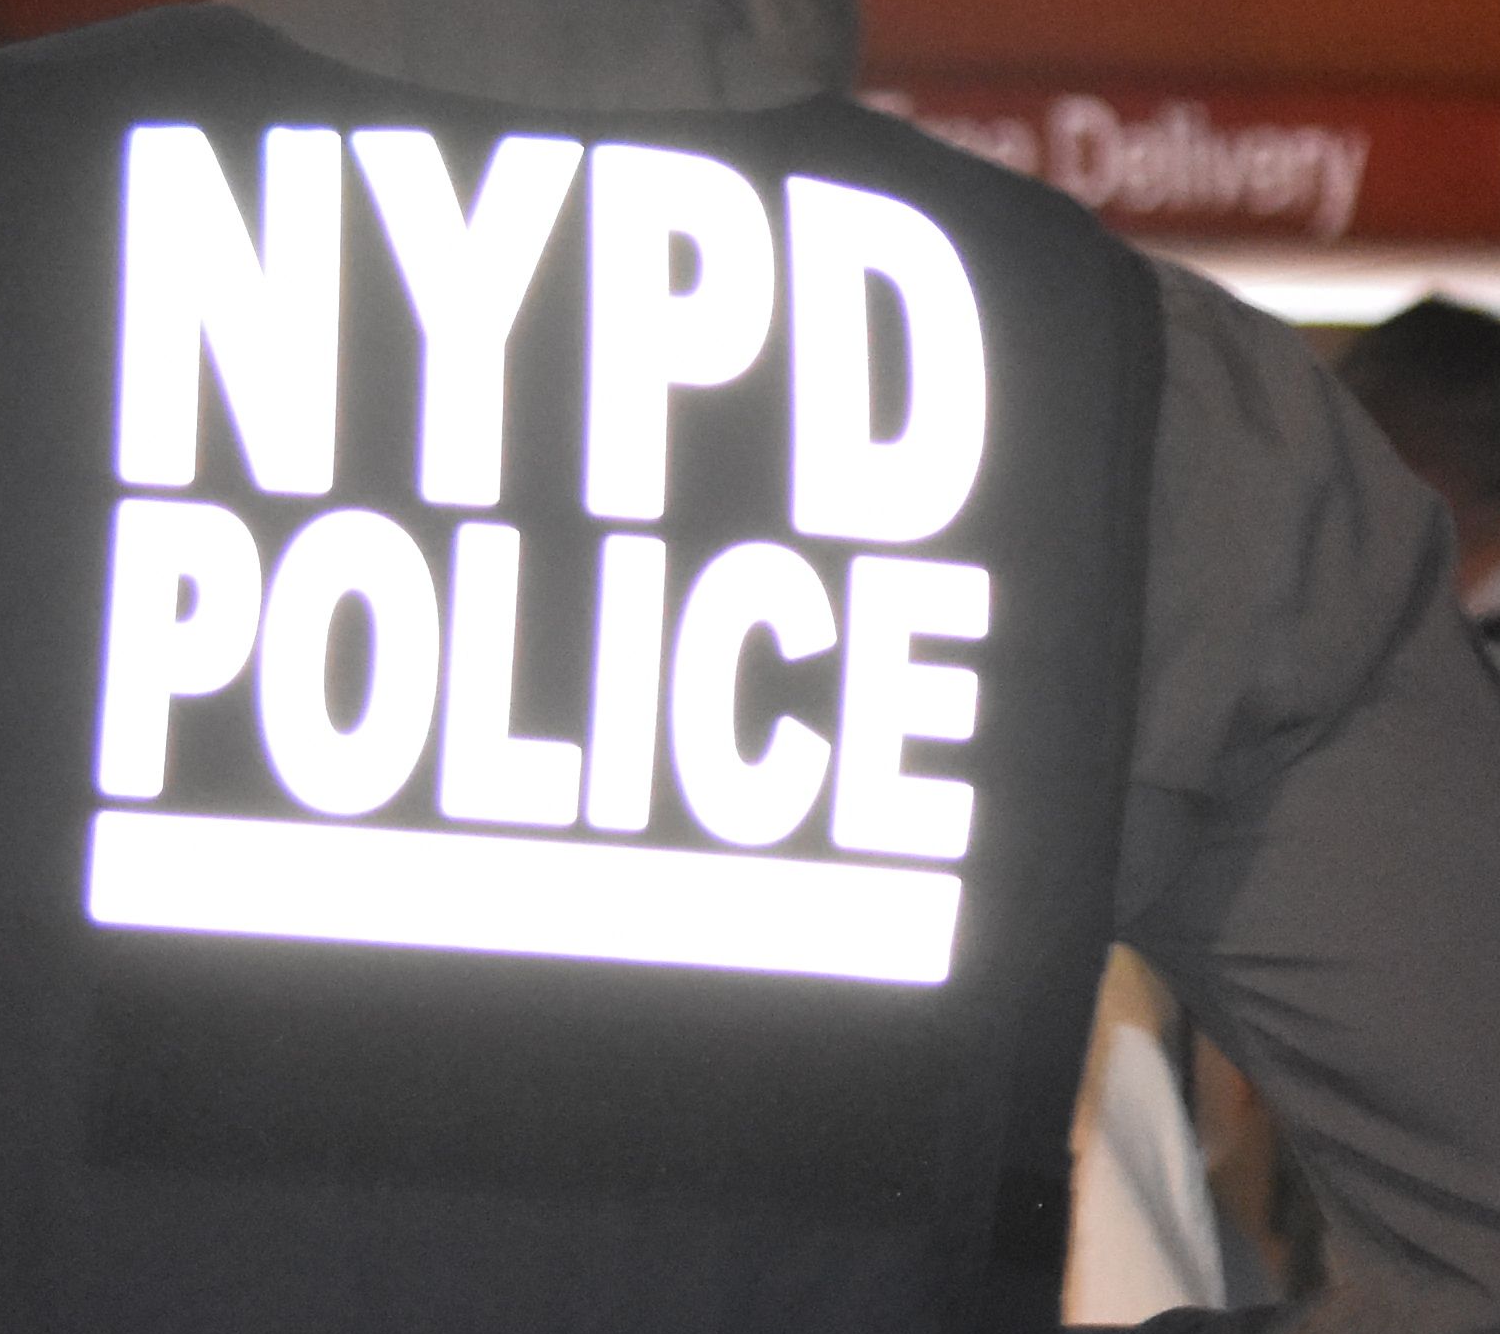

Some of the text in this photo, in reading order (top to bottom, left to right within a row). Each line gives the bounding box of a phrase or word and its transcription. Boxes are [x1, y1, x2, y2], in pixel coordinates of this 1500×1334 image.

[115, 123, 988, 543] NYPD
[1047, 93, 1372, 239] Delivery
[94, 495, 992, 860] POLICE
